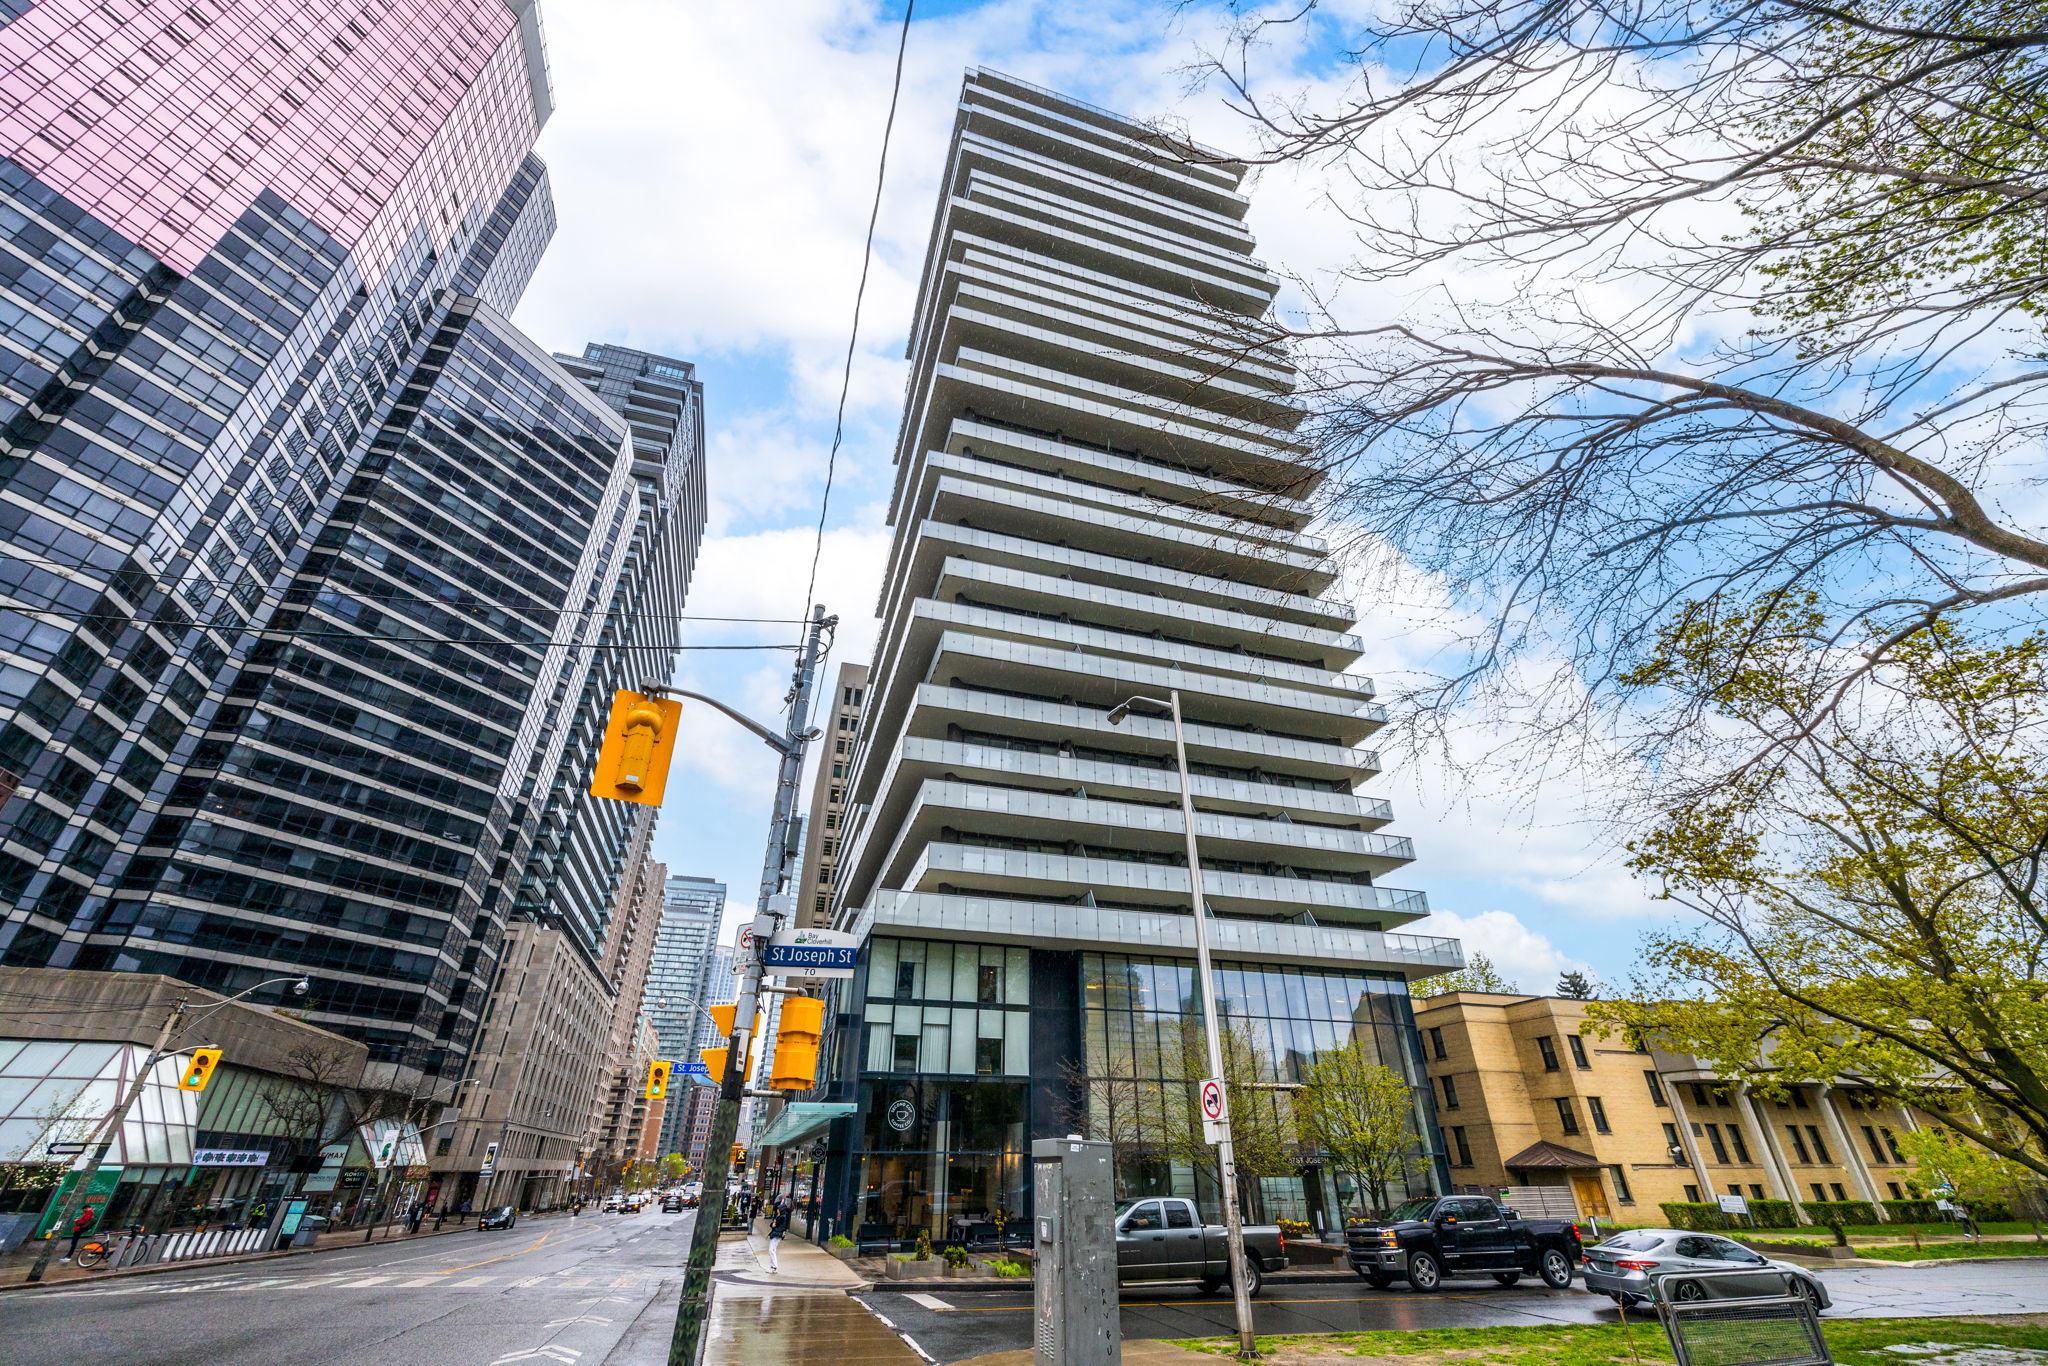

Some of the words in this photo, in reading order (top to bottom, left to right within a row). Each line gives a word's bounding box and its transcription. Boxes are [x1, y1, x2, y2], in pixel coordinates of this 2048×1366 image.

[808, 932, 818, 940] Bay
[771, 947, 785, 960] St
[788, 948, 834, 965] Joseph
[838, 949, 852, 963] St
[688, 1064, 709, 1073] Josep
[891, 1118, 904, 1128] COFFEE
